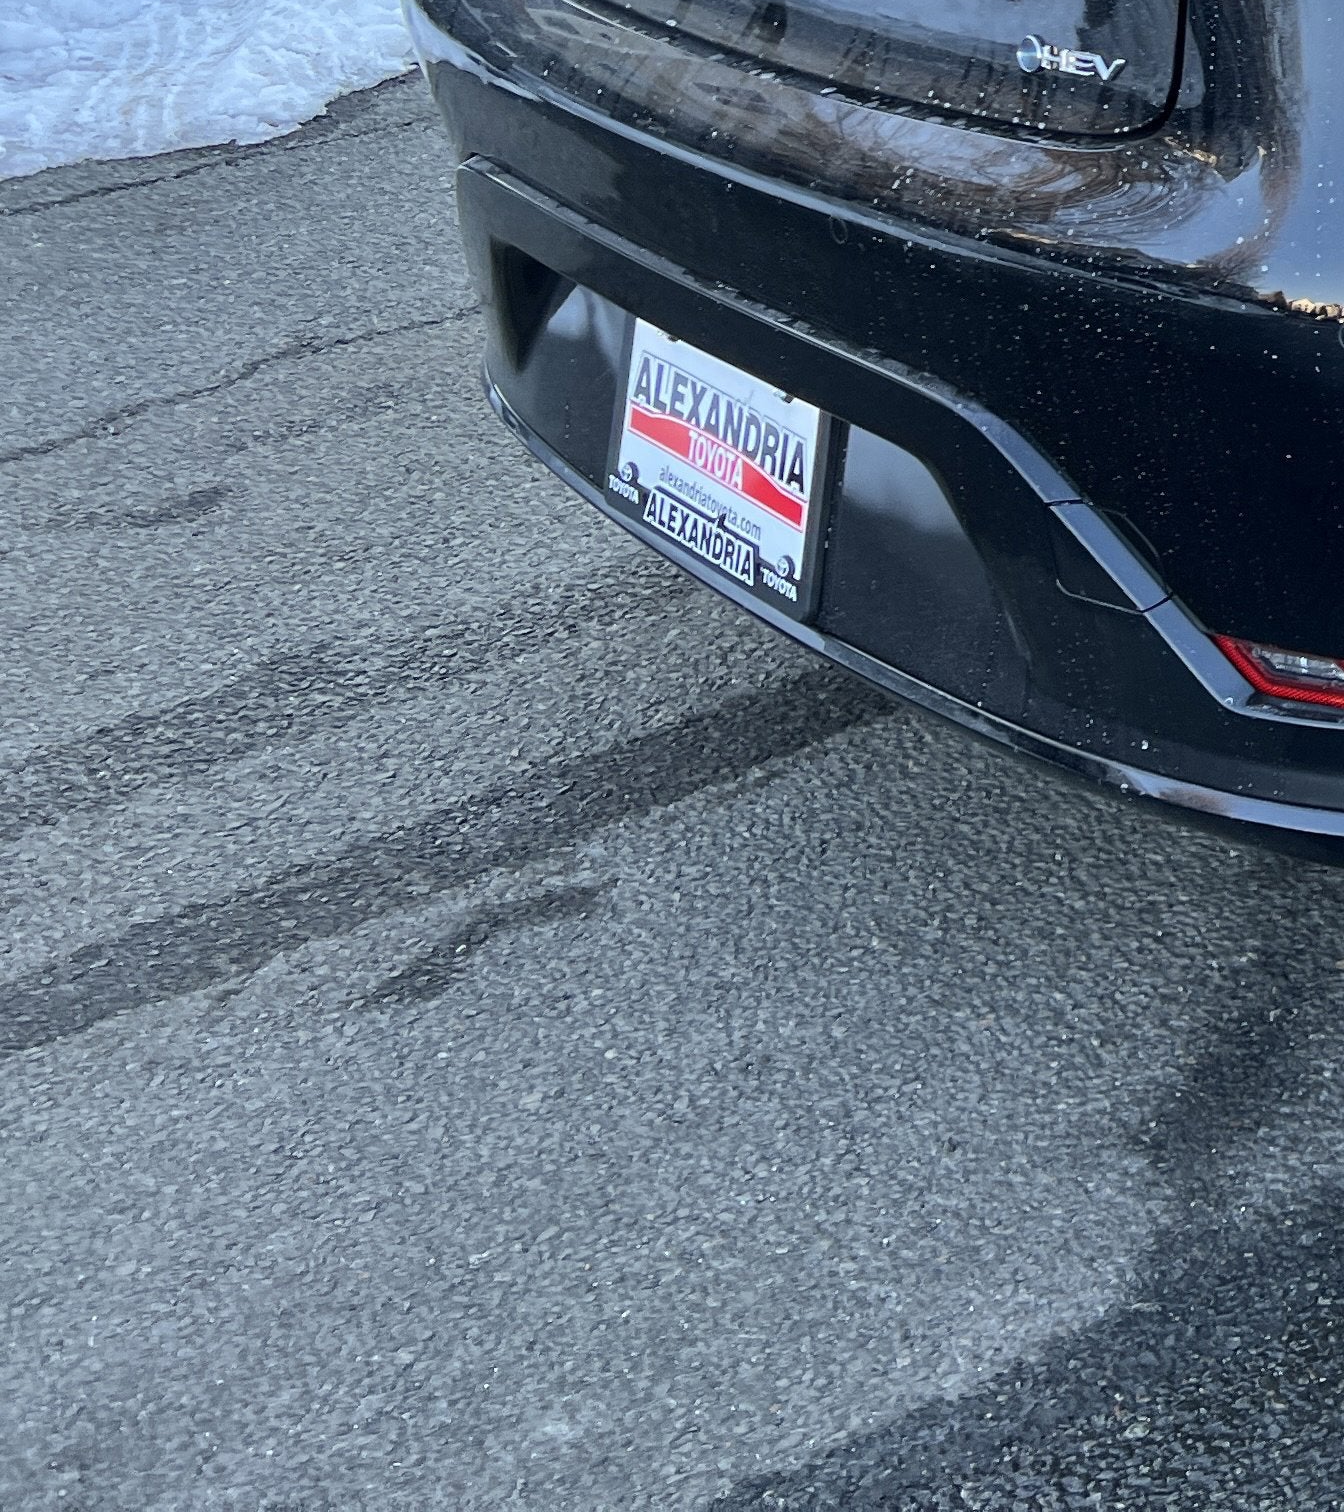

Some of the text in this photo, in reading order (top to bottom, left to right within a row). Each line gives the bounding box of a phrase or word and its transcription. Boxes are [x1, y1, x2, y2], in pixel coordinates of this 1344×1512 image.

[1040, 44, 1126, 81] HEV
[633, 356, 806, 495] ALEXANDRIA
[608, 474, 639, 505] TOYOTA
[687, 430, 744, 491] TOYOTA
[659, 464, 762, 542] alexandriatoyota.com
[645, 490, 754, 586] ALEXANDRIA
[760, 566, 798, 602] TOYOTA
